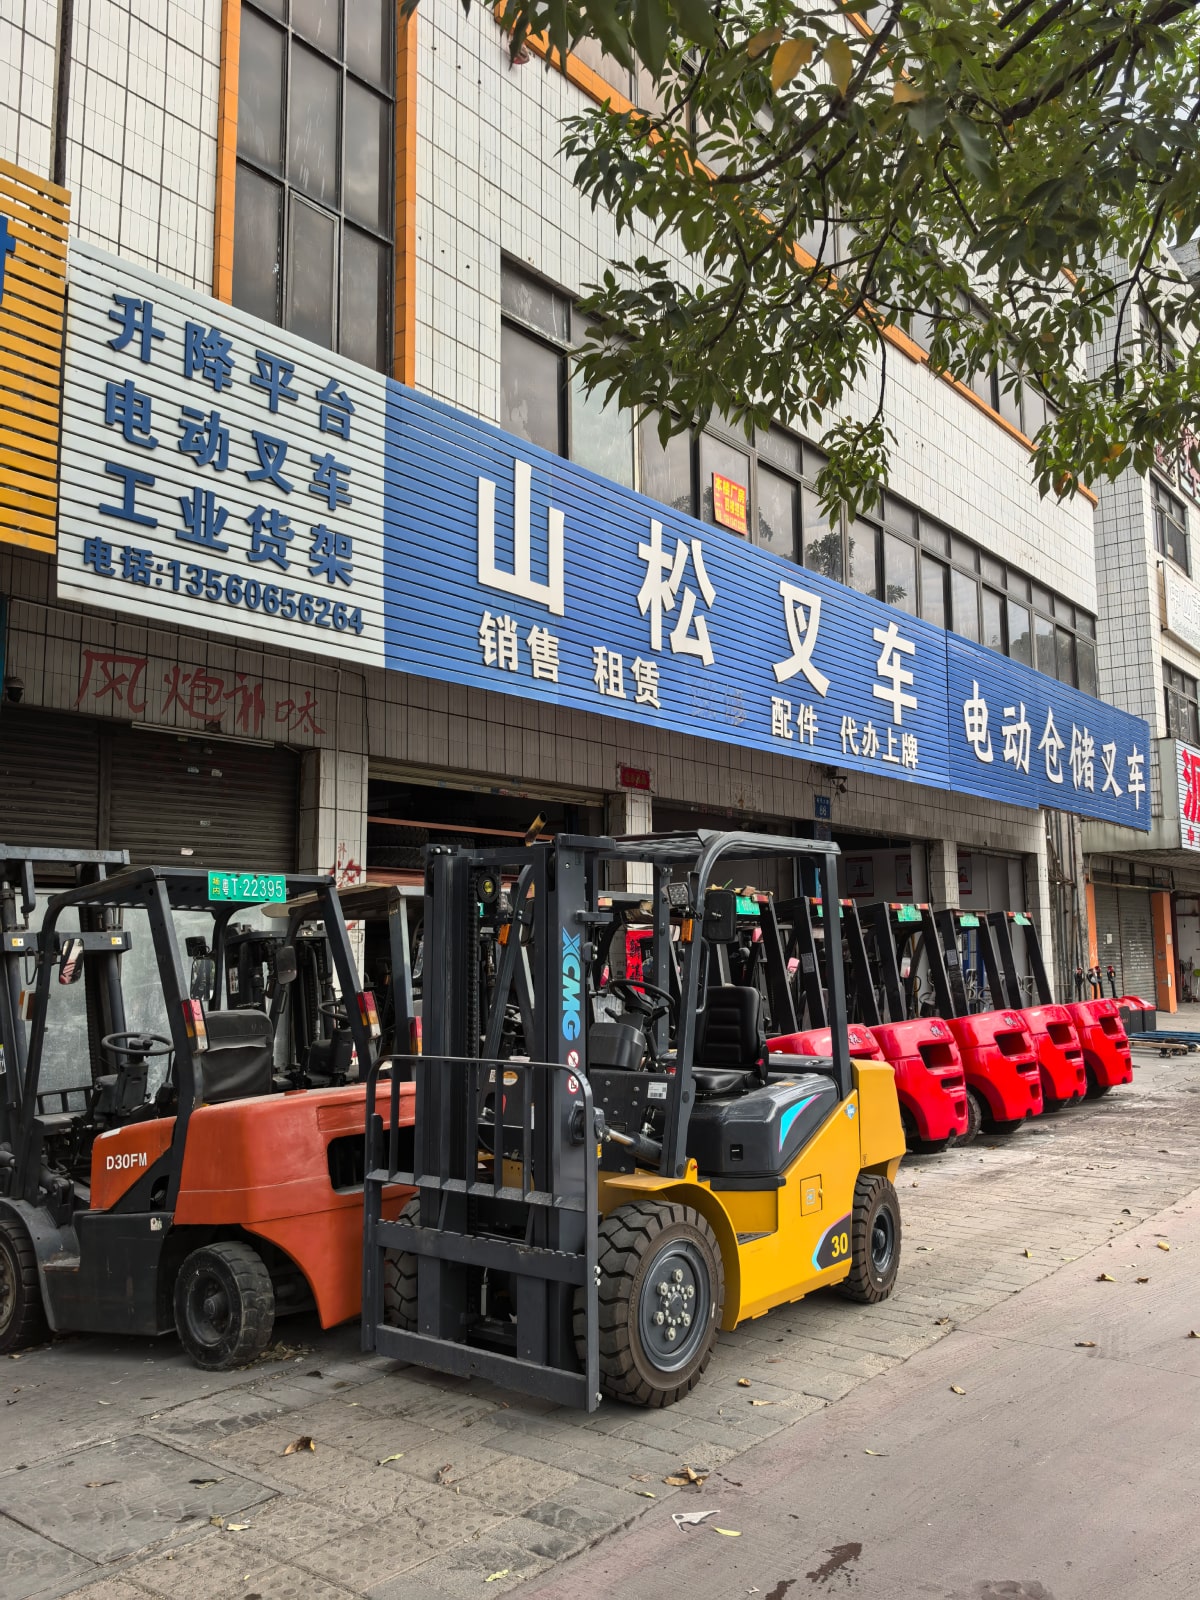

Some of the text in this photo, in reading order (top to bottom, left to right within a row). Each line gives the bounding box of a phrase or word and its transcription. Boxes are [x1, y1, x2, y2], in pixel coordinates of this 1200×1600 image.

[108, 293, 356, 441] 升降平台
[104, 380, 353, 511] 电动叉车
[83, 536, 364, 635] 电话:13560656264
[99, 461, 354, 587] 工业货架
[478, 458, 918, 726] 山松叉车
[478, 610, 560, 683] 销售
[592, 646, 661, 710] 租赁
[771, 695, 819, 746] 配件
[839, 715, 919, 770] 代办上牌
[963, 679, 1146, 811] 电动仓储叉车
[562, 926, 581, 1041] XCMG
[106, 1152, 147, 1170] D30FM
[831, 1232, 848, 1258] 30
